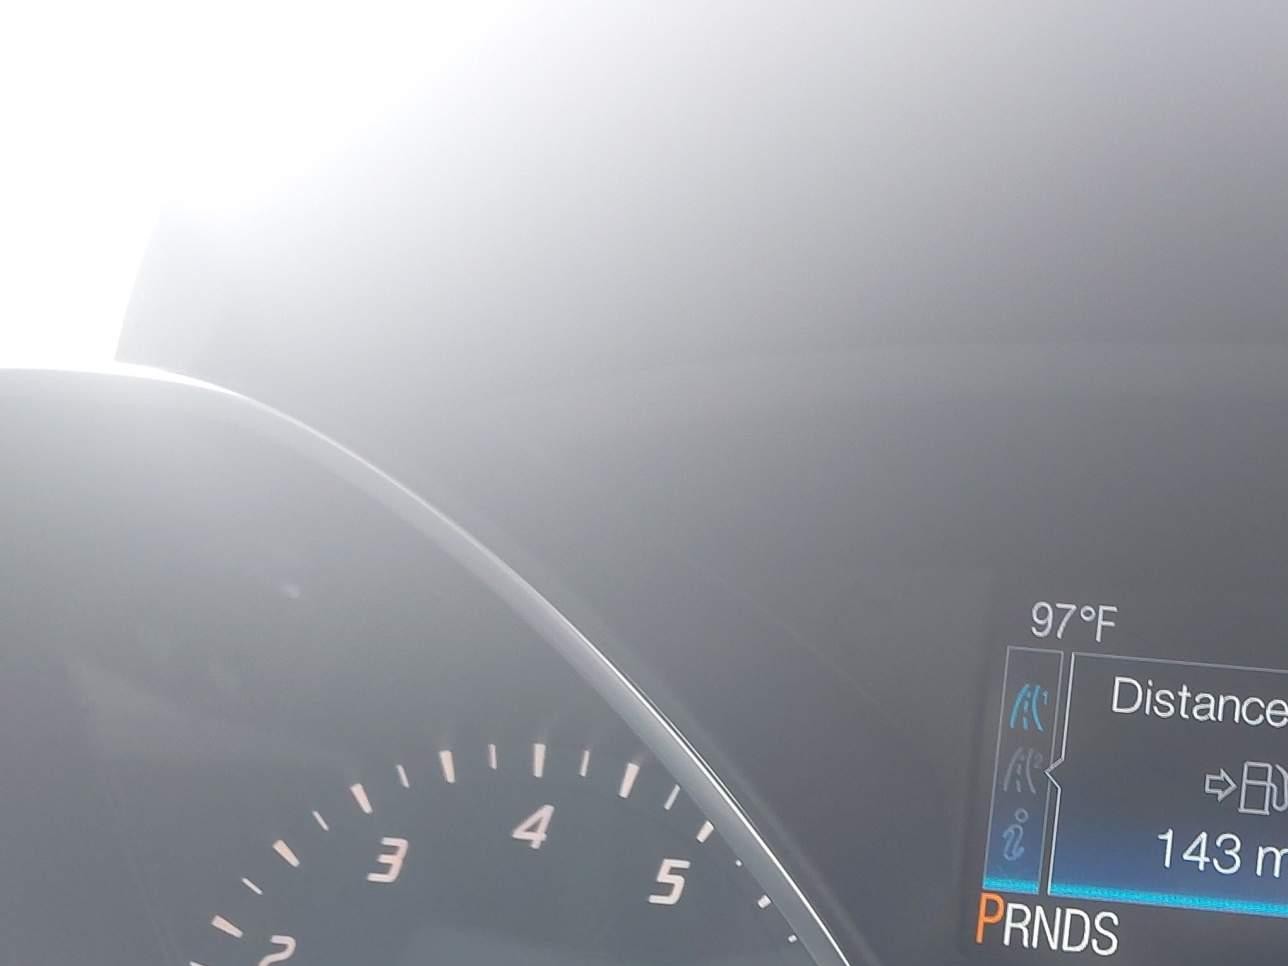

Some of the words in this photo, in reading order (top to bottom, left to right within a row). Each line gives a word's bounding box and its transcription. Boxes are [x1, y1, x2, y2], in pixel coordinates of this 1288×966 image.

[1031, 601, 1118, 643] 97°F
[512, 805, 554, 849] 4
[368, 838, 408, 882] 3
[1156, 829, 1242, 876] 143
[649, 859, 690, 905] 5
[974, 892, 1119, 957] PRNDS
